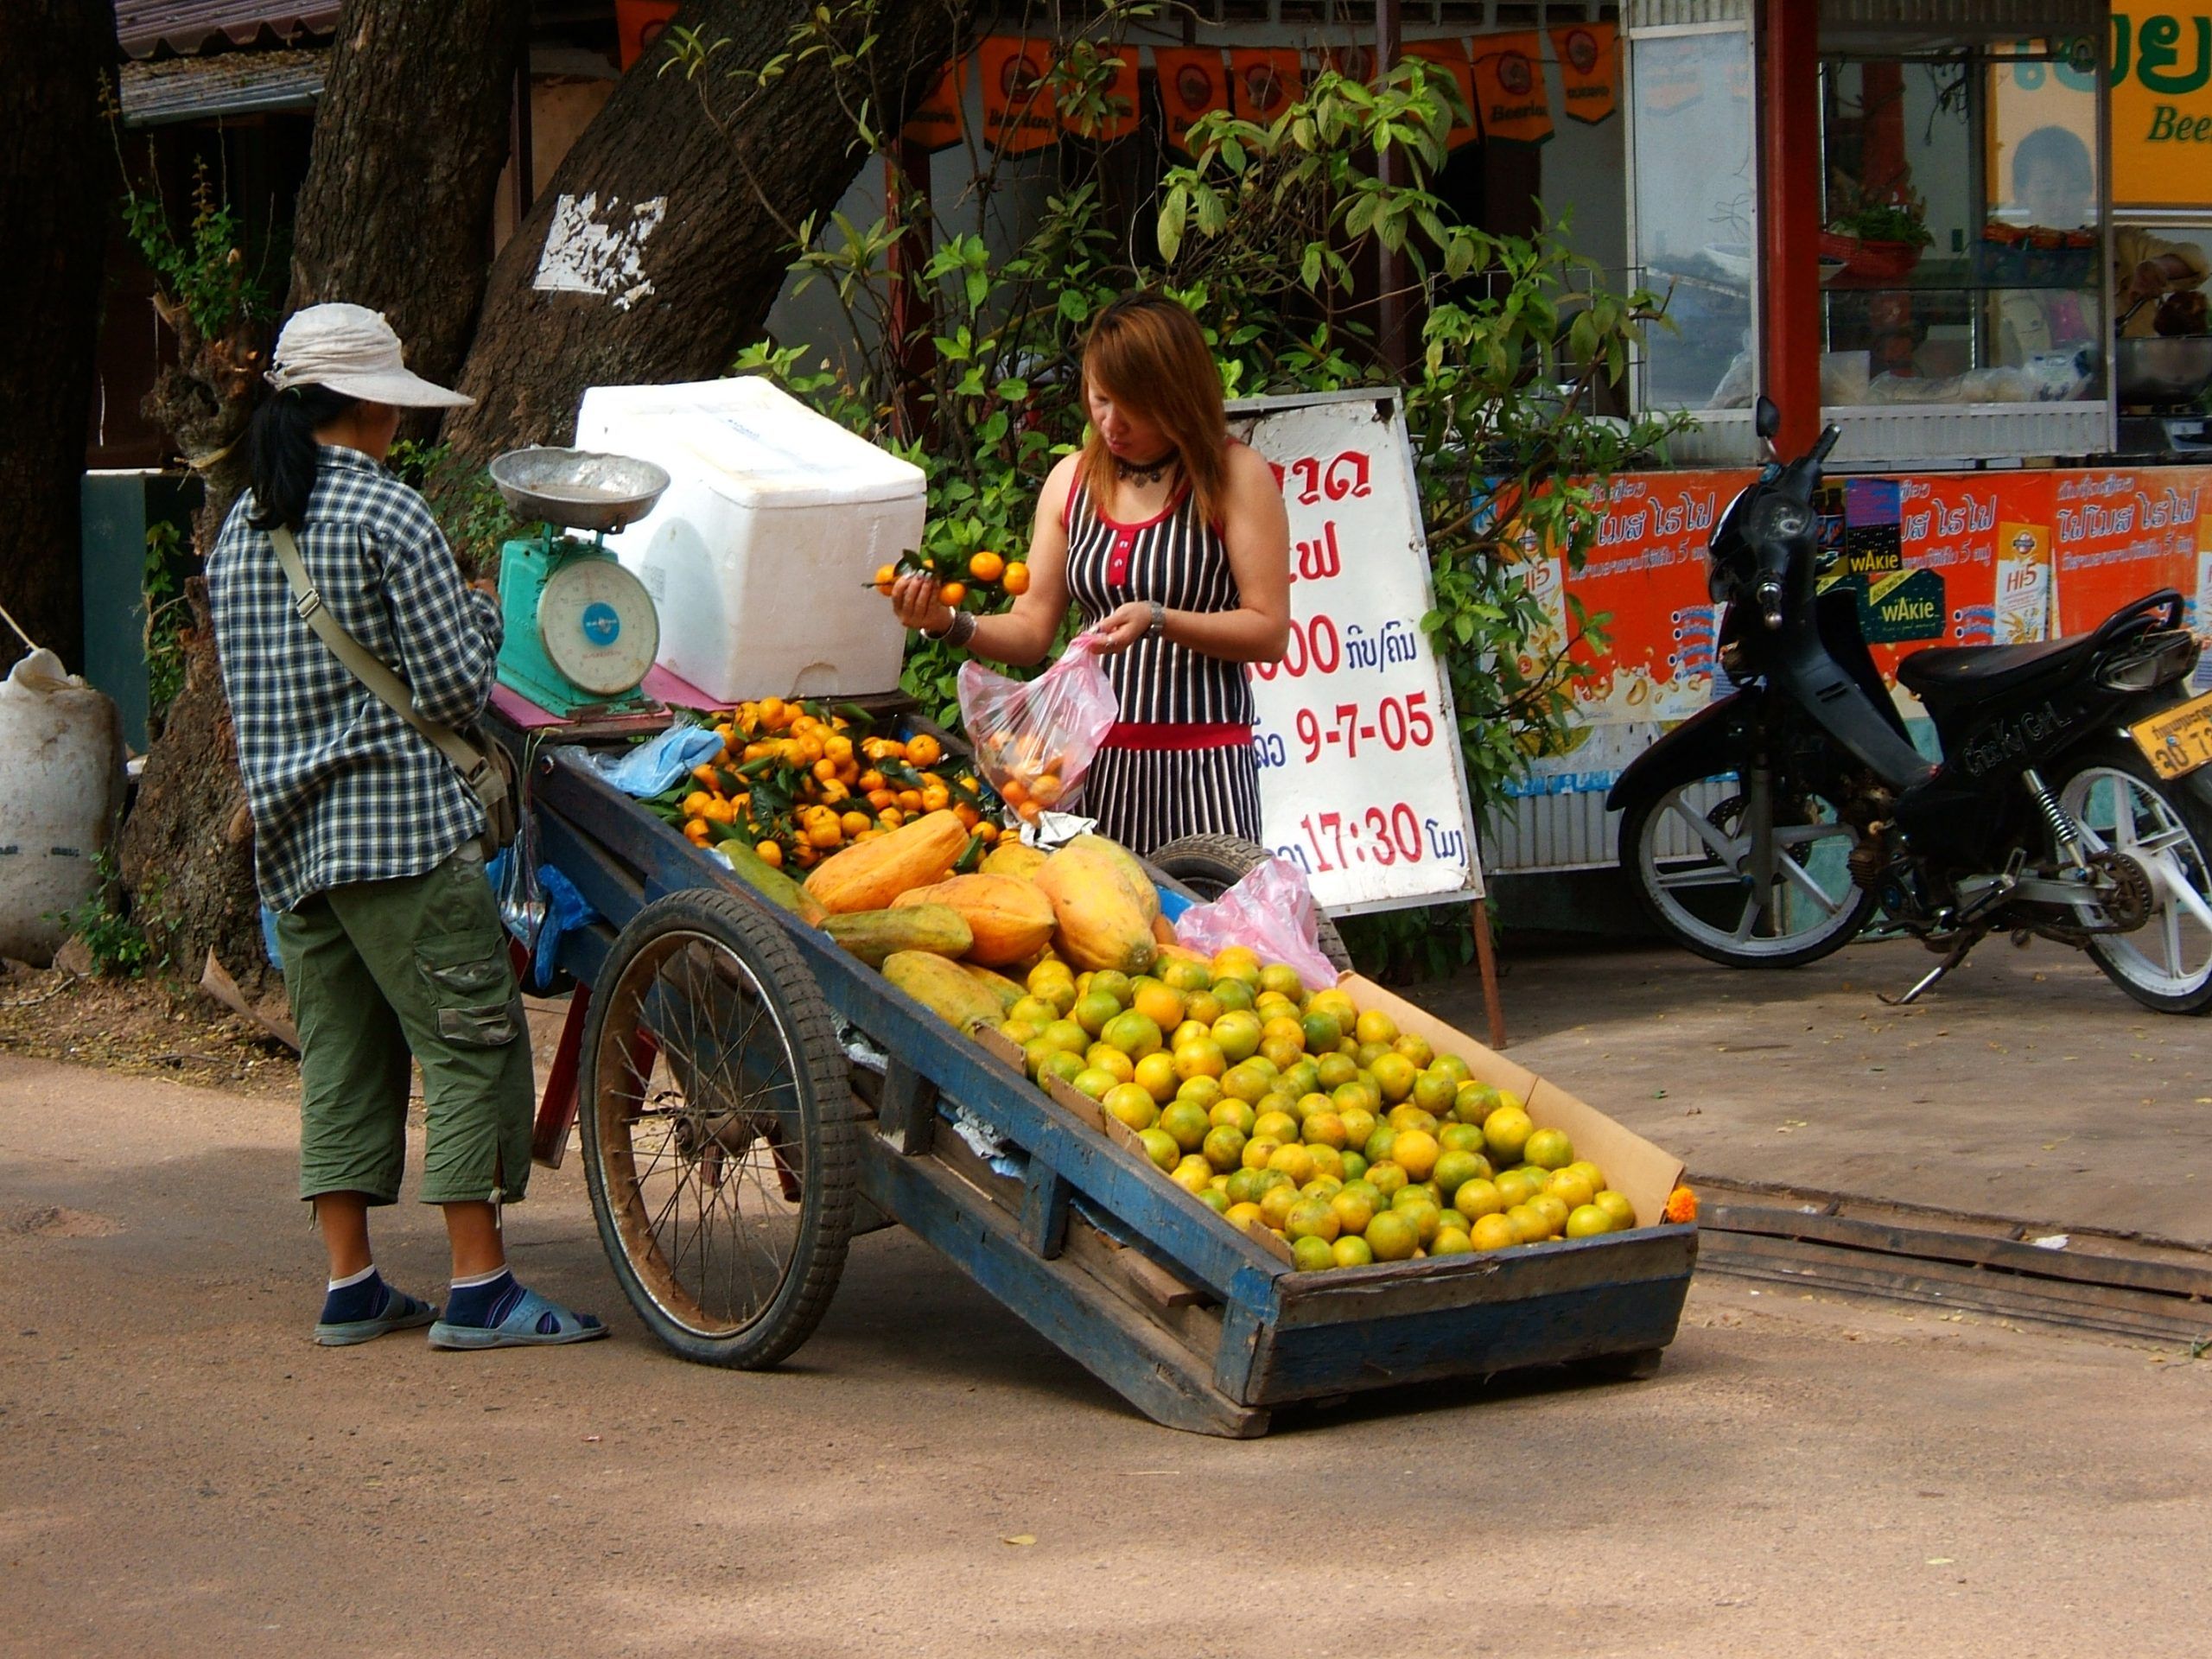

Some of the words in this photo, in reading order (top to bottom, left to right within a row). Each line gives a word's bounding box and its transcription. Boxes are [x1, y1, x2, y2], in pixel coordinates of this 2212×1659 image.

[2146, 105, 2212, 142] Bee
[1268, 450, 1372, 505] າດ
[1296, 690, 1434, 763] 9-7-05
[1300, 802, 1422, 873] 17:30
